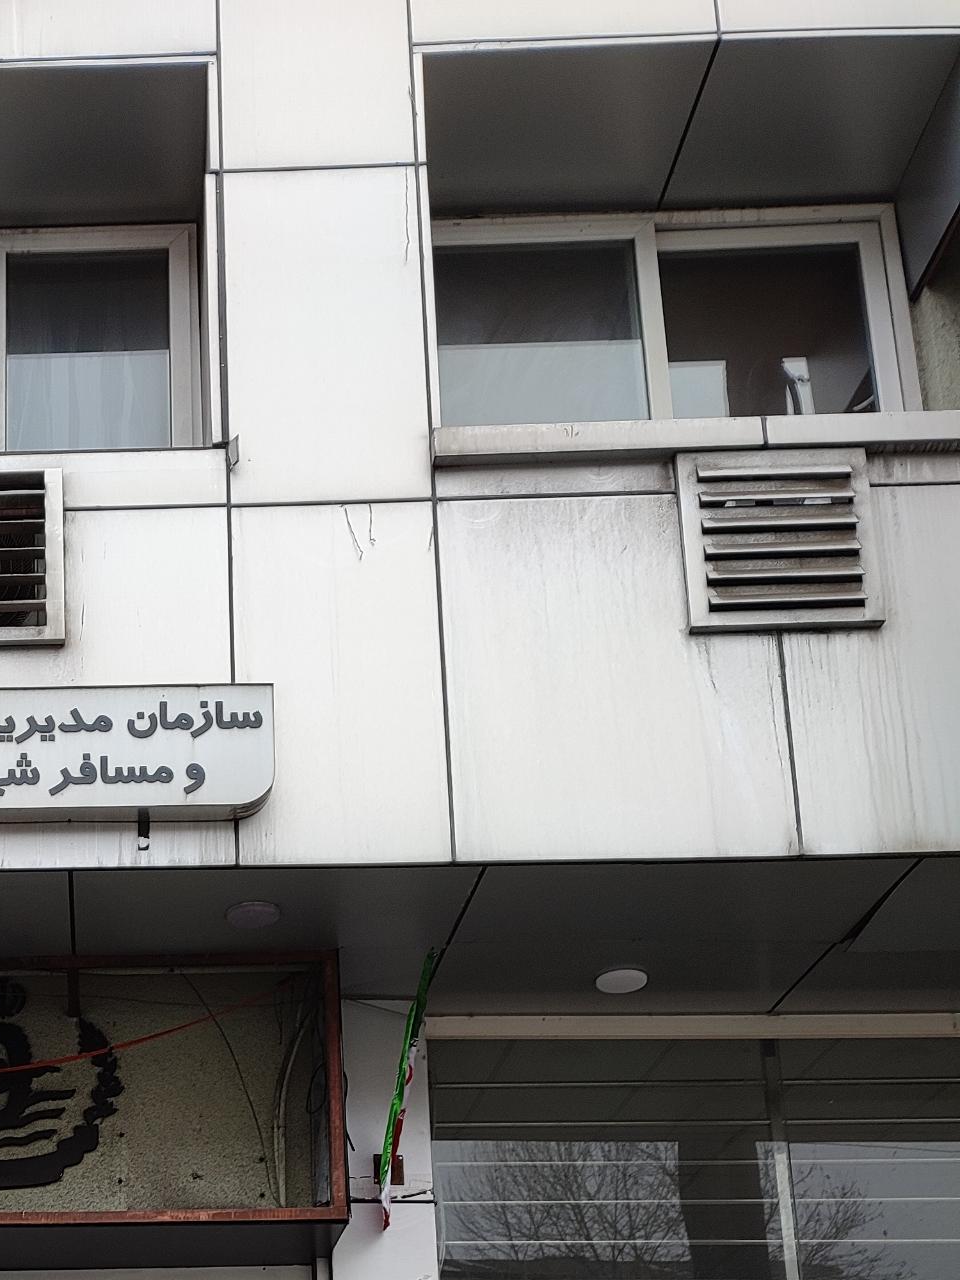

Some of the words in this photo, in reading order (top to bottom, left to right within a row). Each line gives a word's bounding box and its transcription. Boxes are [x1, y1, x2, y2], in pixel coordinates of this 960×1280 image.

[126, 700, 264, 741] سازمان
[49, 752, 175, 797] مسافر
[184, 761, 206, 795] و
